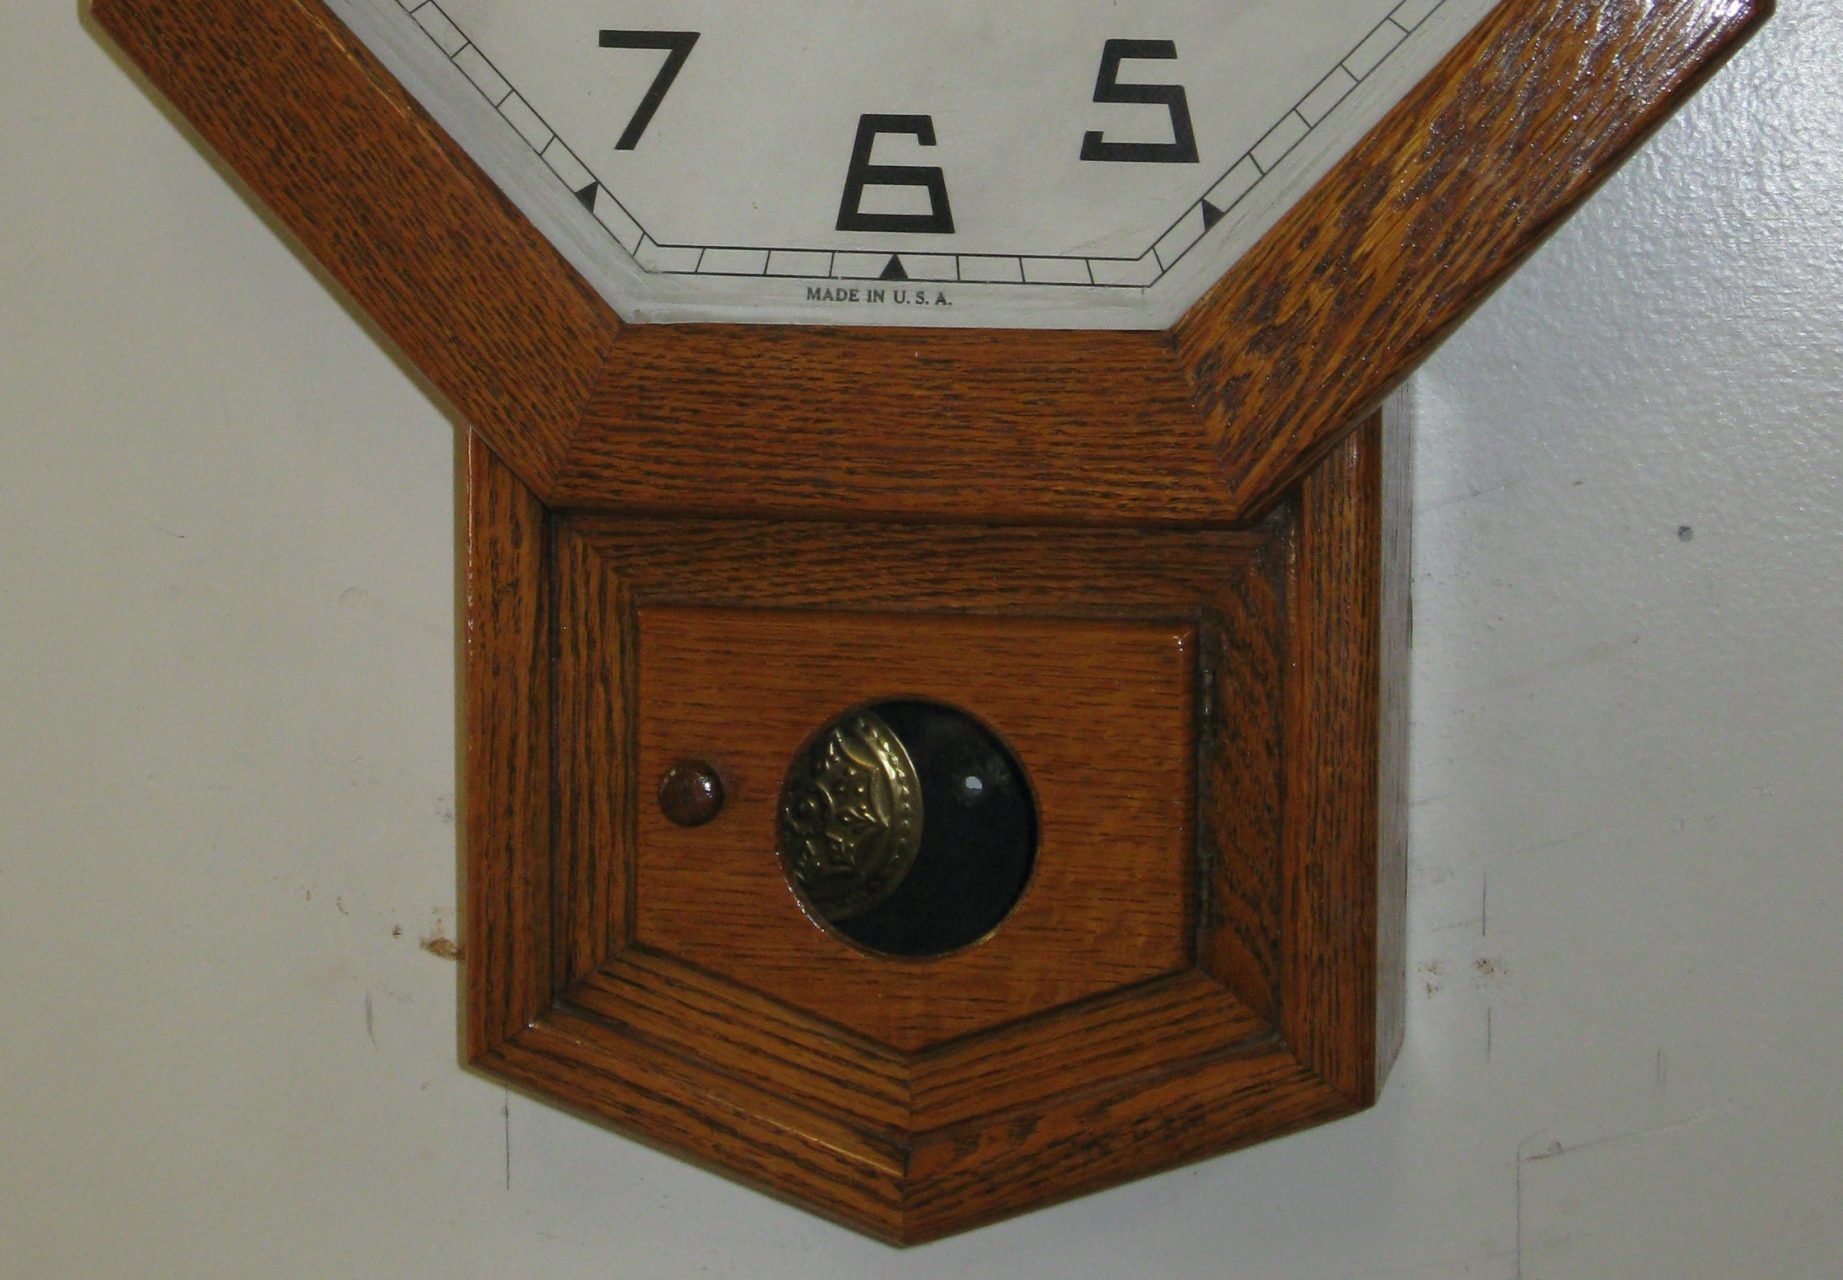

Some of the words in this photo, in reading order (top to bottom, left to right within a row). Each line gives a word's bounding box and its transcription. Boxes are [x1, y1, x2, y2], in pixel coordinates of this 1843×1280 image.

[599, 30, 700, 150] 7
[1080, 39, 1199, 163] 5
[836, 114, 955, 234] 6
[806, 287, 860, 303] MADE
[866, 289, 885, 303] IN
